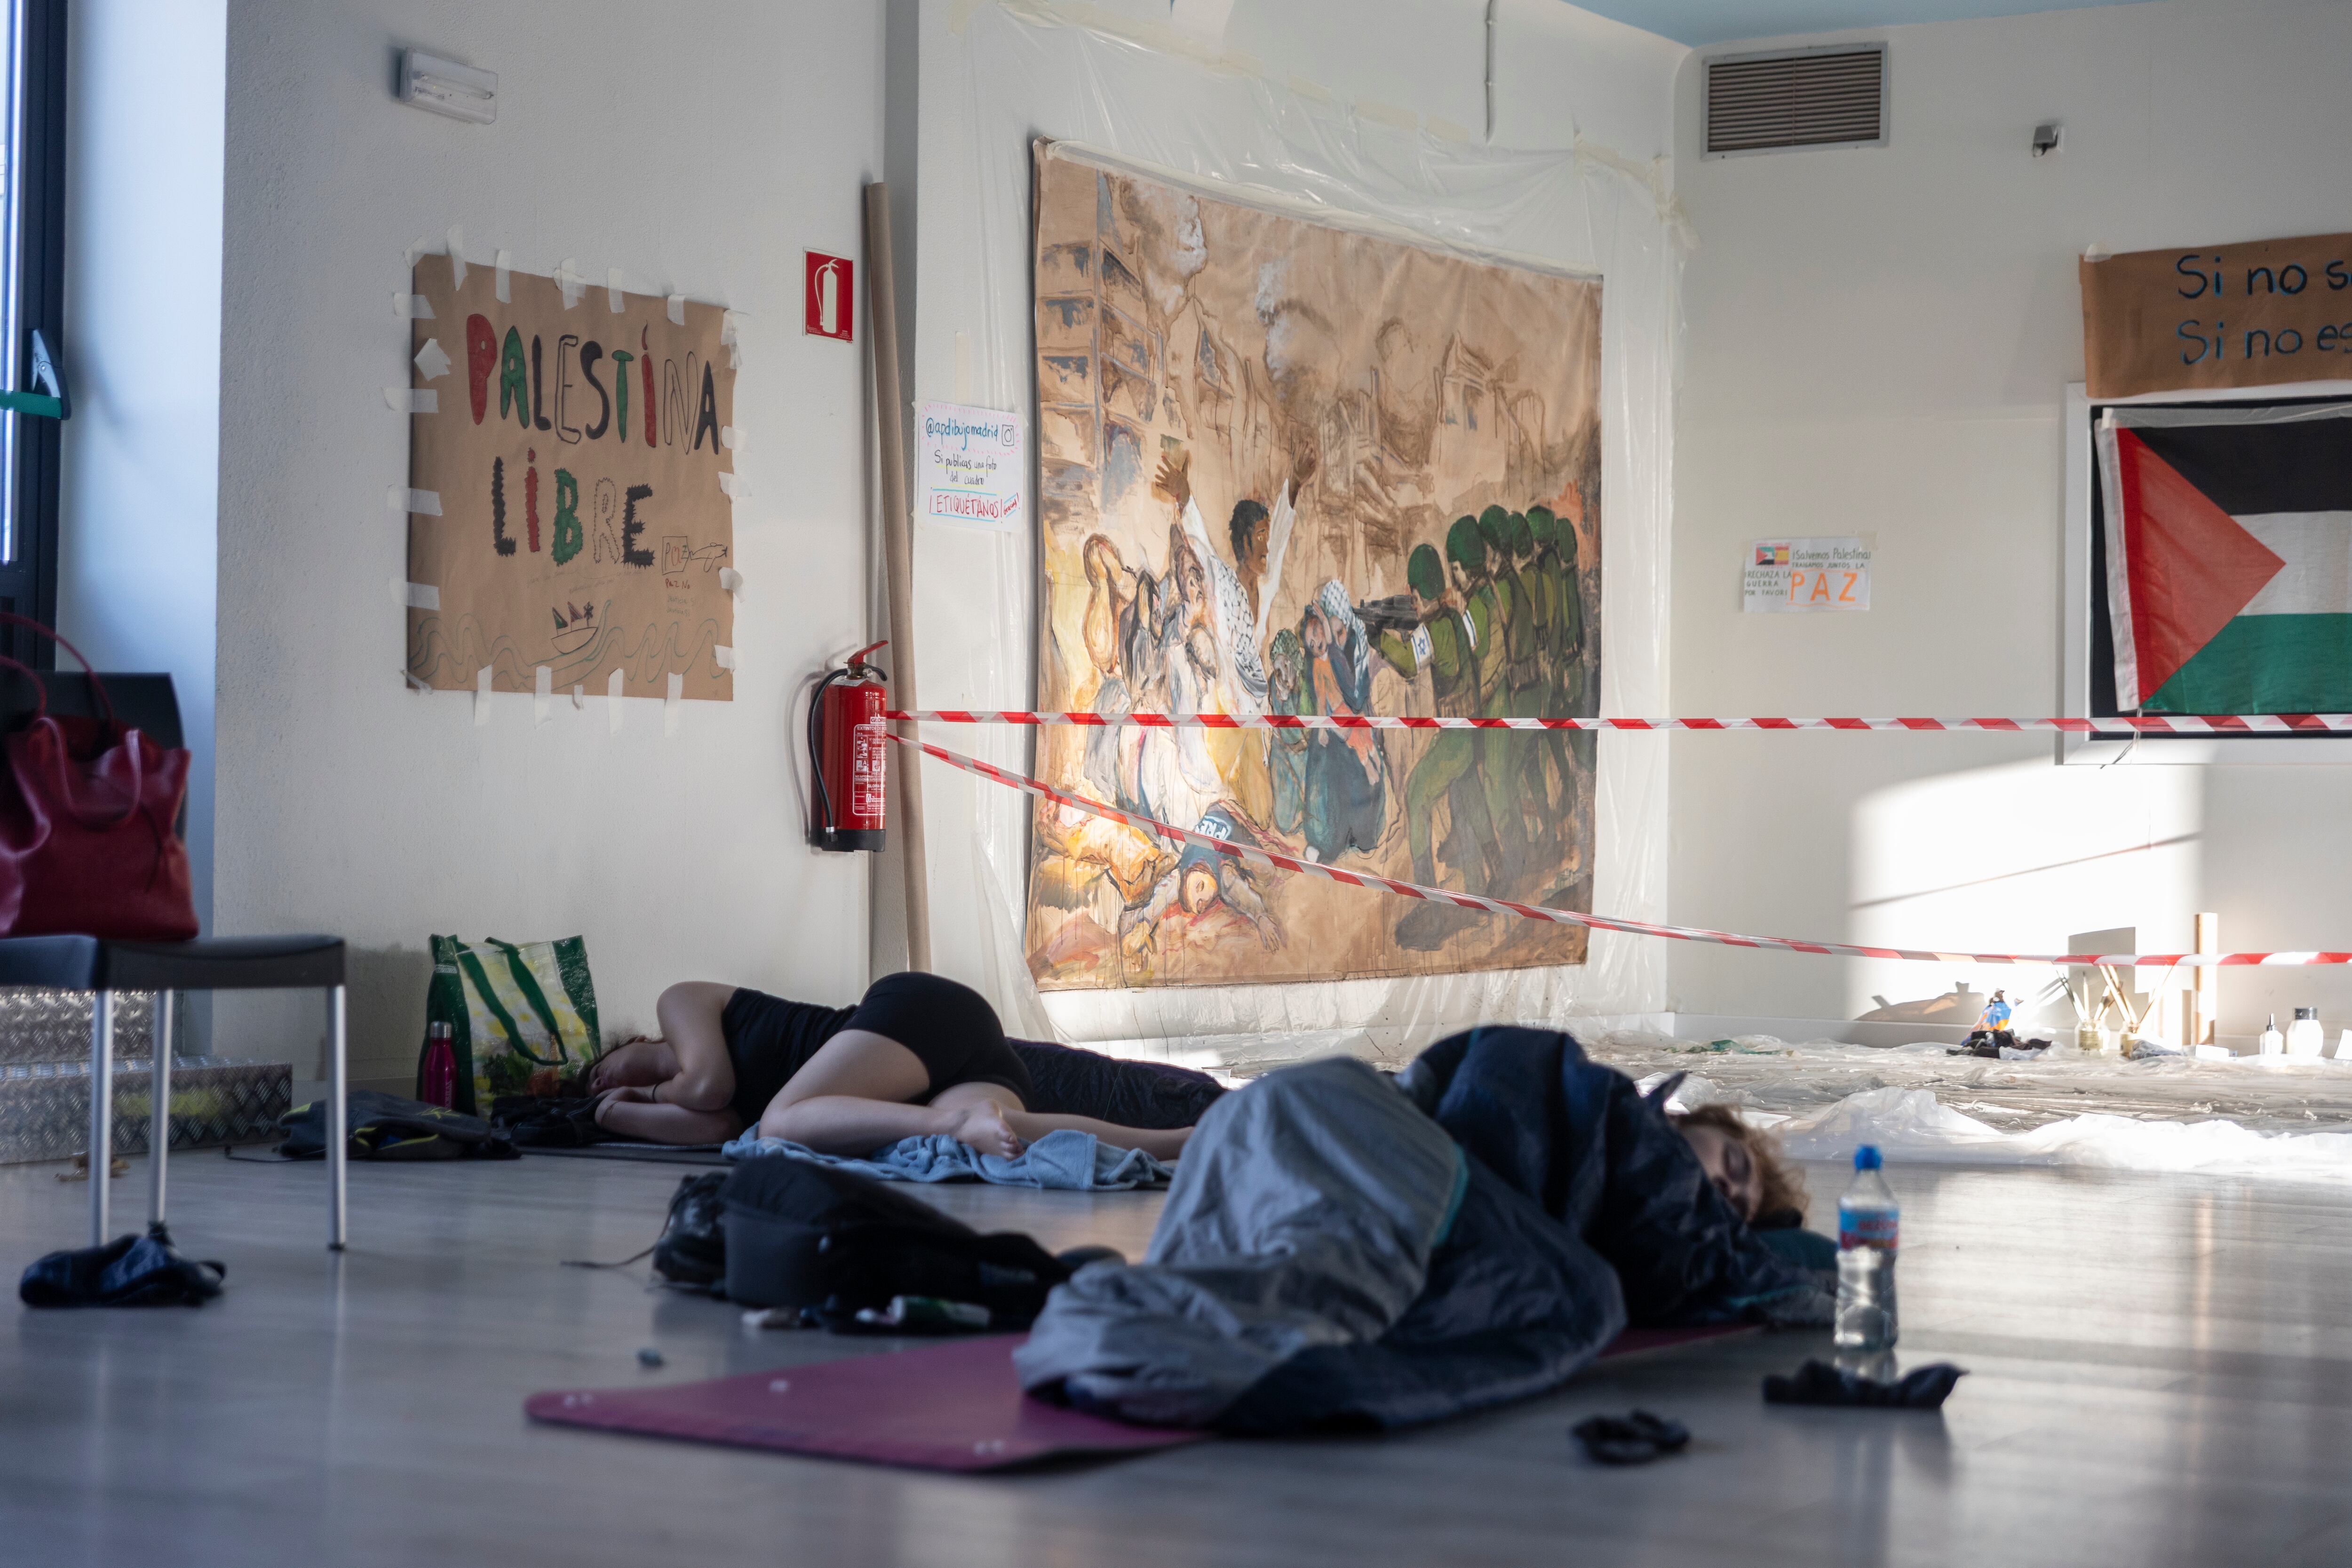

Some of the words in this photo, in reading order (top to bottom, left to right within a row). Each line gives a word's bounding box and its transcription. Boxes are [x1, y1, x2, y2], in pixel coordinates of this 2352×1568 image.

[2175, 255, 2223, 298] Si
[2247, 263, 2307, 296] no
[2324, 260, 2352, 291] s
[2176, 320, 2223, 365] Si
[2245, 329, 2303, 358] no
[926, 417, 998, 451] @apdibujomadrid
[934, 449, 943, 463] Si
[946, 454, 971, 474] publicas
[974, 461, 984, 469] una
[985, 455, 997, 478] foto
[964, 474, 984, 485] cuadro
[1783, 570, 1792, 579] LA
[1789, 572, 1858, 602] PAZ
